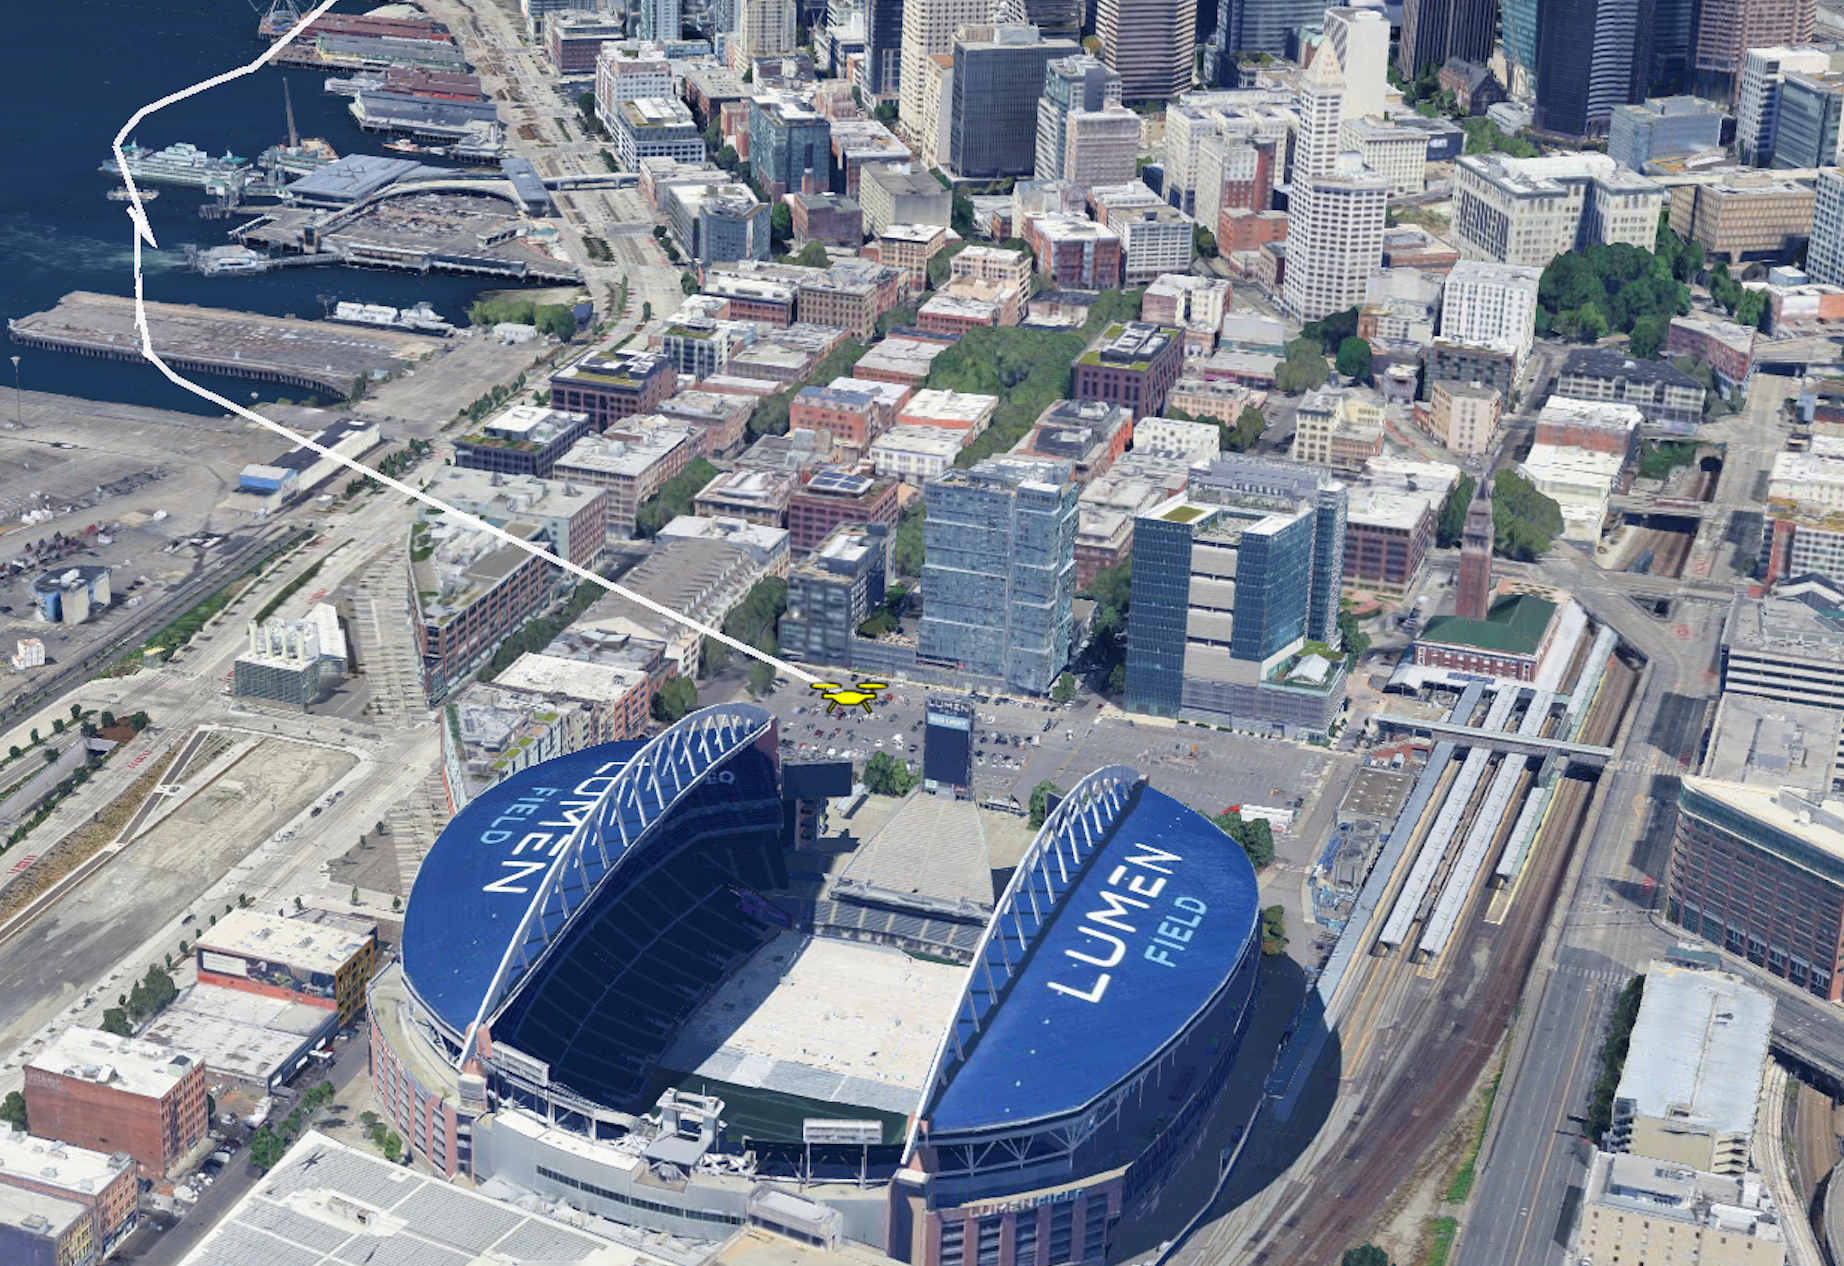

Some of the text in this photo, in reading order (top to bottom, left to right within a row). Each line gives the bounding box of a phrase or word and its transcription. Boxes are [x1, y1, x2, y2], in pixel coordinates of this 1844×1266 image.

[928, 699, 970, 713] LUMEN
[480, 787, 561, 845] FIELD
[1046, 843, 1183, 1003] LUMEN
[1143, 896, 1207, 968] FIELD
